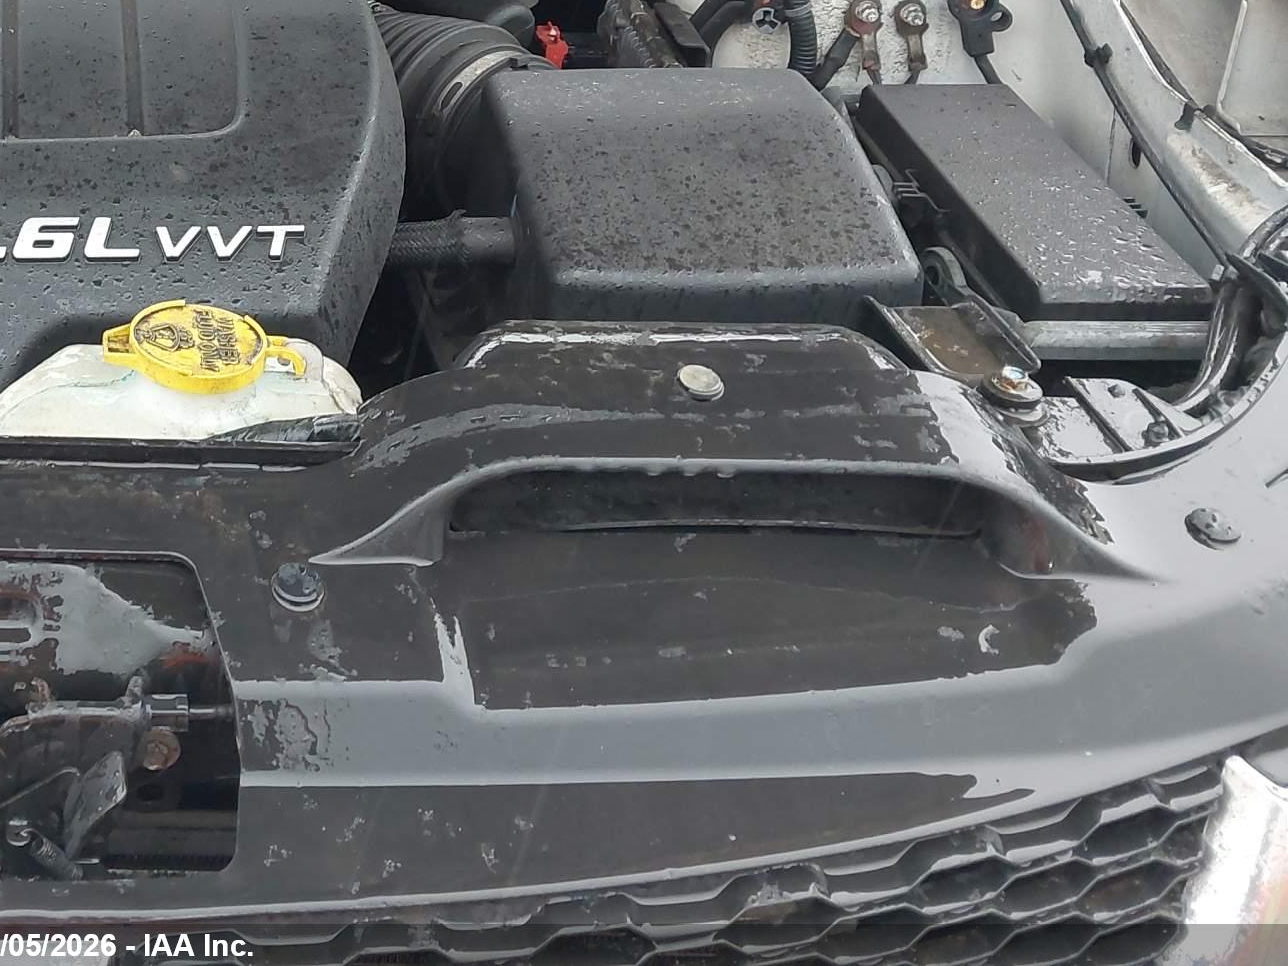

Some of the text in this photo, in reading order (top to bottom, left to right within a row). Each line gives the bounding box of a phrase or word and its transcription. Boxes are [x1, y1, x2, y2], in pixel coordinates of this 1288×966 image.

[155, 224, 307, 262] VVT
[193, 309, 220, 373] FLUID ONLY
[215, 316, 241, 366] WASHER
